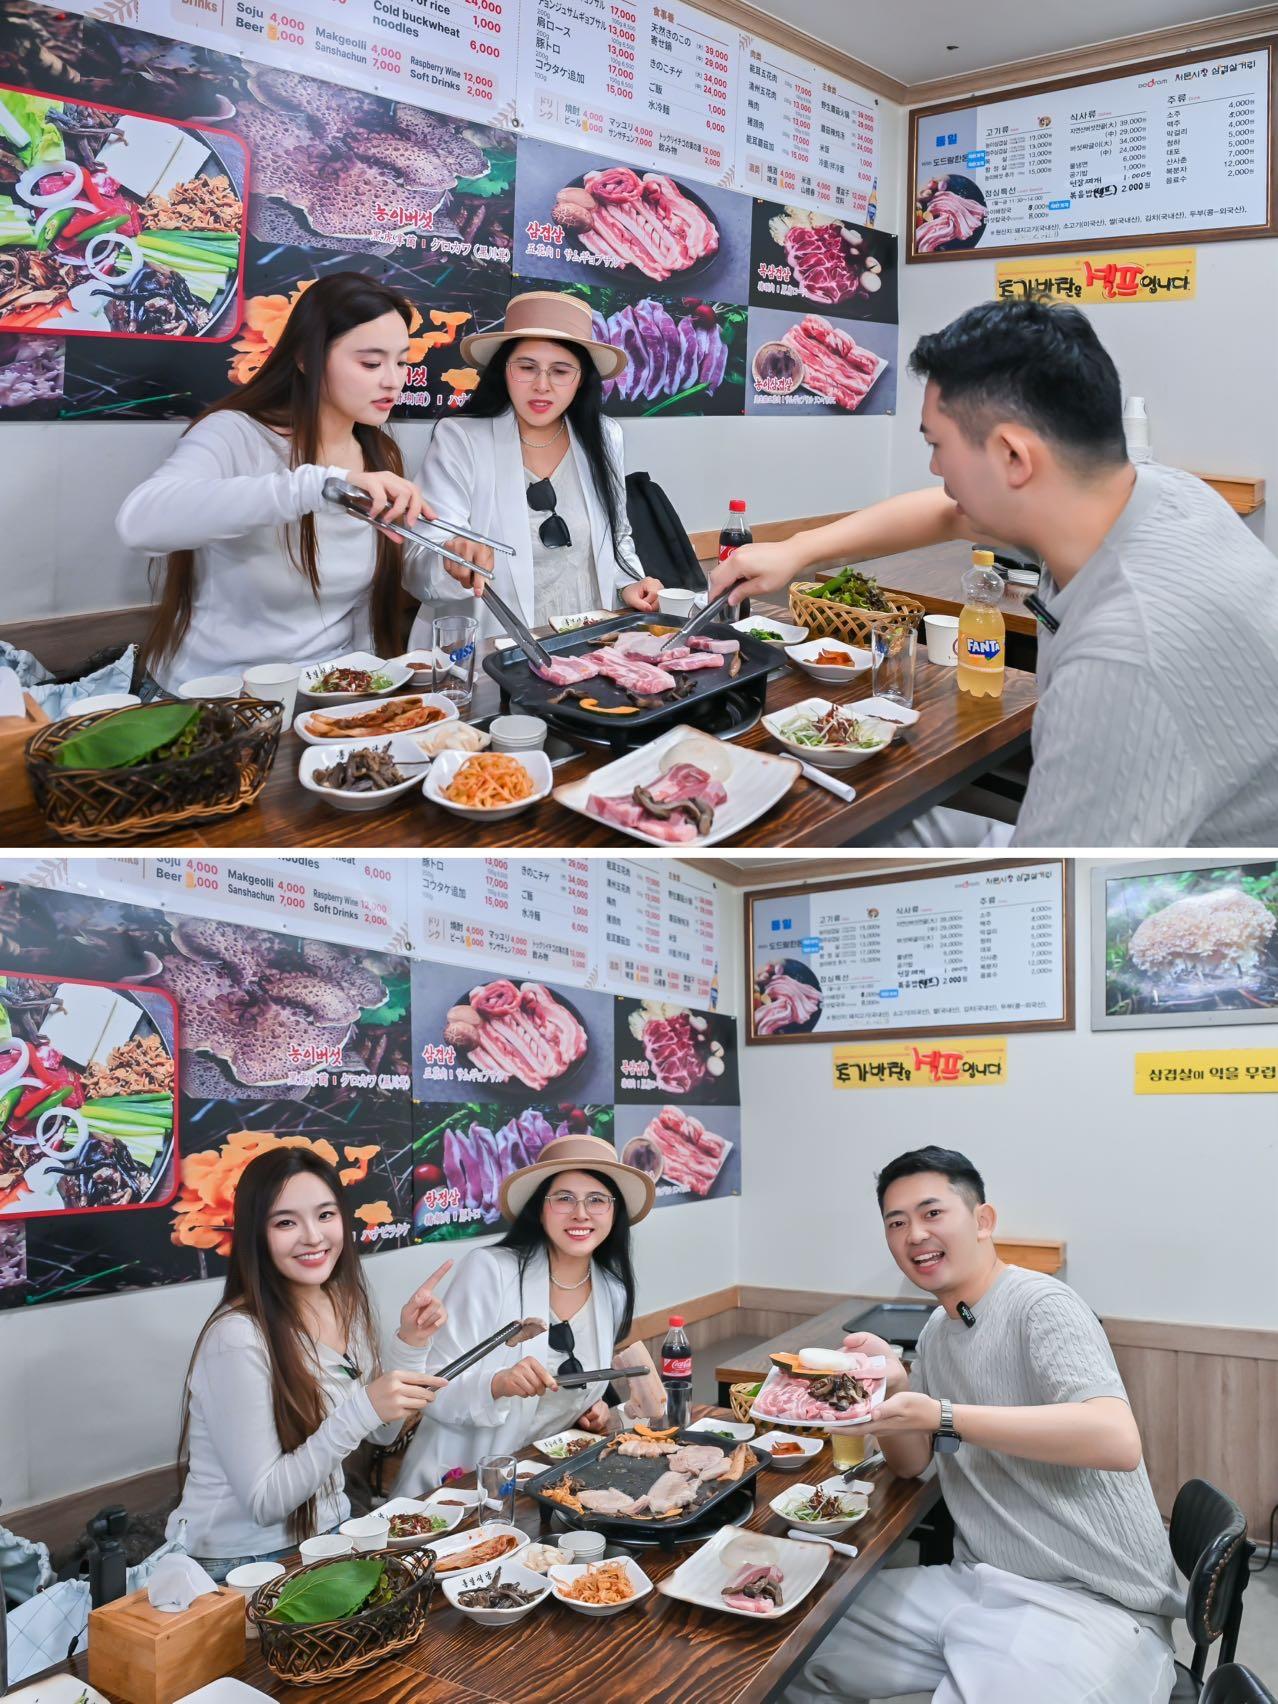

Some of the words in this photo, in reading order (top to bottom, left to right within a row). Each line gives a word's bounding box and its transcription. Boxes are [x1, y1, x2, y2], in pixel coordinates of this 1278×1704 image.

[236, 2, 264, 19] Soju
[270, 13, 305, 31] 4,000
[430, 0, 450, 15] rice
[610, 5, 636, 23] 17,000
[235, 17, 264, 33] Beer
[373, 0, 400, 18] Cold
[402, 6, 460, 38] buckwheat
[473, 15, 502, 33] 1,000
[373, 14, 420, 38] noodles
[608, 24, 635, 42] 13,000
[315, 27, 367, 50] Makgeolli
[371, 44, 402, 61] 4,000
[608, 44, 634, 61] 13,000
[705, 45, 729, 61] 39,000
[315, 41, 367, 64] Sanshachun
[372, 57, 401, 74] 7,000
[470, 40, 500, 58] 6,000
[704, 57, 728, 73] 29,000
[410, 56, 444, 76] Raspberry
[445, 66, 461, 78] Wine
[463, 72, 493, 88] 12,000
[535, 58, 585, 85] コウタケ追加
[606, 83, 632, 99] 15,000
[608, 64, 633, 80] 17,000
[703, 73, 727, 89] 34,000
[410, 69, 430, 82] Soft
[431, 76, 461, 92] Drinks
[466, 86, 493, 100] 2,000
[703, 85, 726, 101] 24,000
[708, 104, 726, 117] 1,000
[633, 125, 653, 139] 4,000
[706, 120, 725, 135] 6,000
[634, 138, 653, 149] 7,000
[372, 203, 434, 230] 능이버섯
[525, 220, 566, 244] 삼겹살
[967, 638, 1000, 653] FANTA
[156, 868, 182, 885] Beer
[187, 859, 218, 878] 4,000
[228, 868, 274, 888] Makgeolli
[278, 880, 305, 895] 4,000
[364, 865, 391, 880] 6,000
[485, 875, 508, 891] 17,000
[228, 882, 275, 903] Sanshachun
[279, 895, 305, 908] 7,000
[484, 895, 508, 910] 15,000
[313, 901, 331, 914] Soft
[332, 907, 359, 921] Drinks
[365, 913, 387, 926] 2,000
[287, 1044, 343, 1067] 능이버섯
[422, 1044, 456, 1065] 삼겹살
[1148, 1067, 1205, 1082] 삼겹살이
[1209, 1066, 1239, 1081] 익을
[1244, 1065, 1277, 1080] 무렵
[424, 1187, 461, 1210] 항정살
